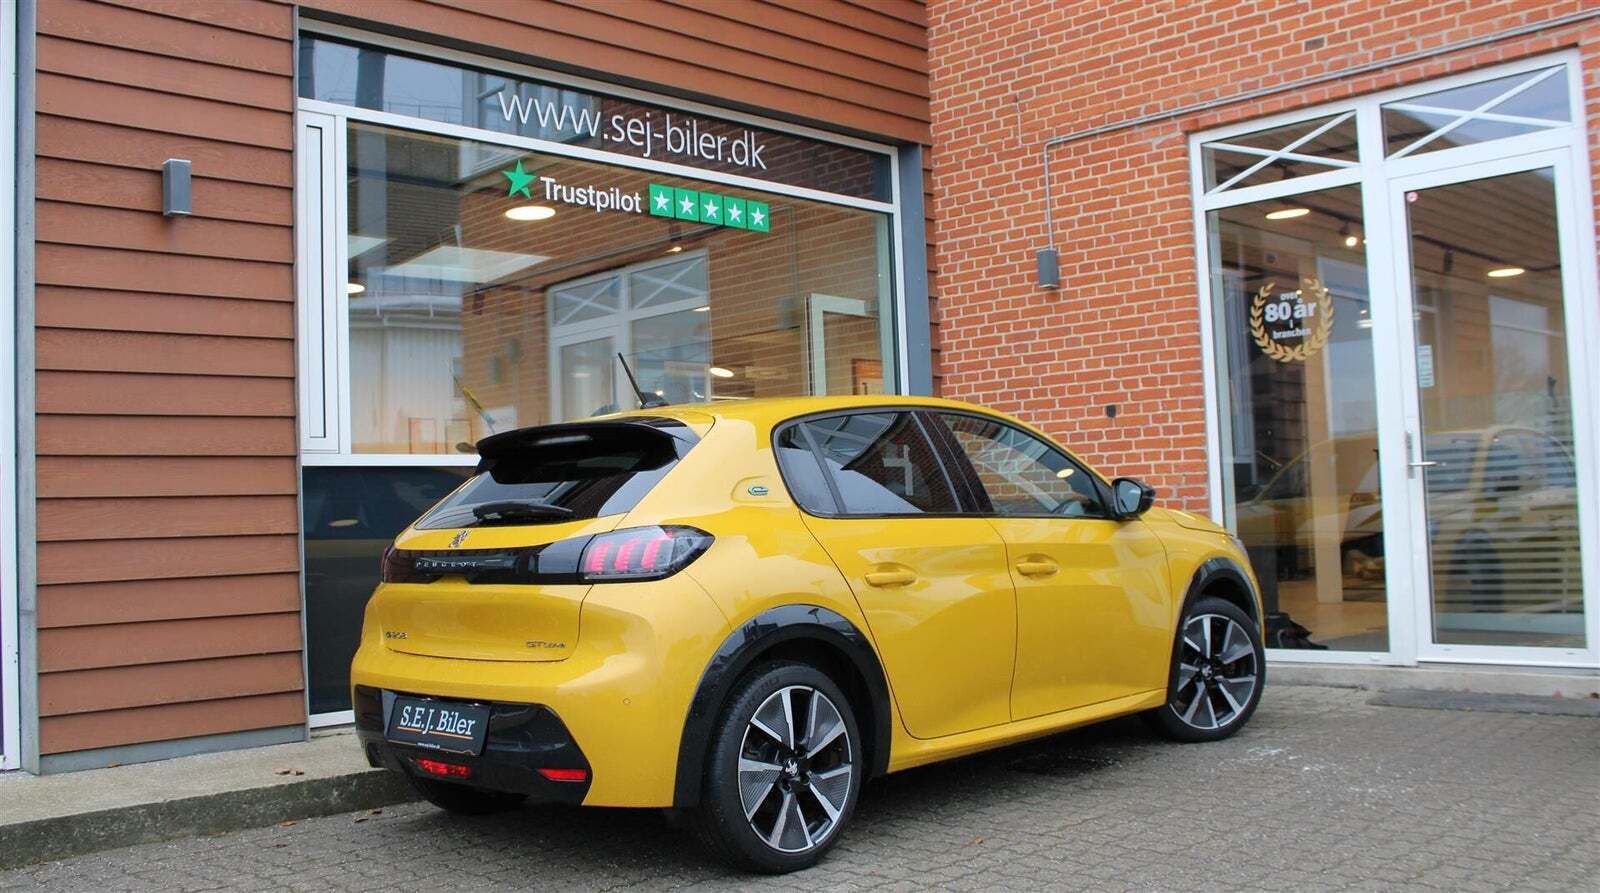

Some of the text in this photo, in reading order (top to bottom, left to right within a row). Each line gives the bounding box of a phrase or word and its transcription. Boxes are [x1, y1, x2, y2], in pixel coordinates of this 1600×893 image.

[498, 92, 767, 170] www.sej-biler.dk
[540, 176, 642, 213] Trustpilot
[1264, 298, 1317, 322] 80 år
[400, 705, 476, 736] S.E.J. Biler
